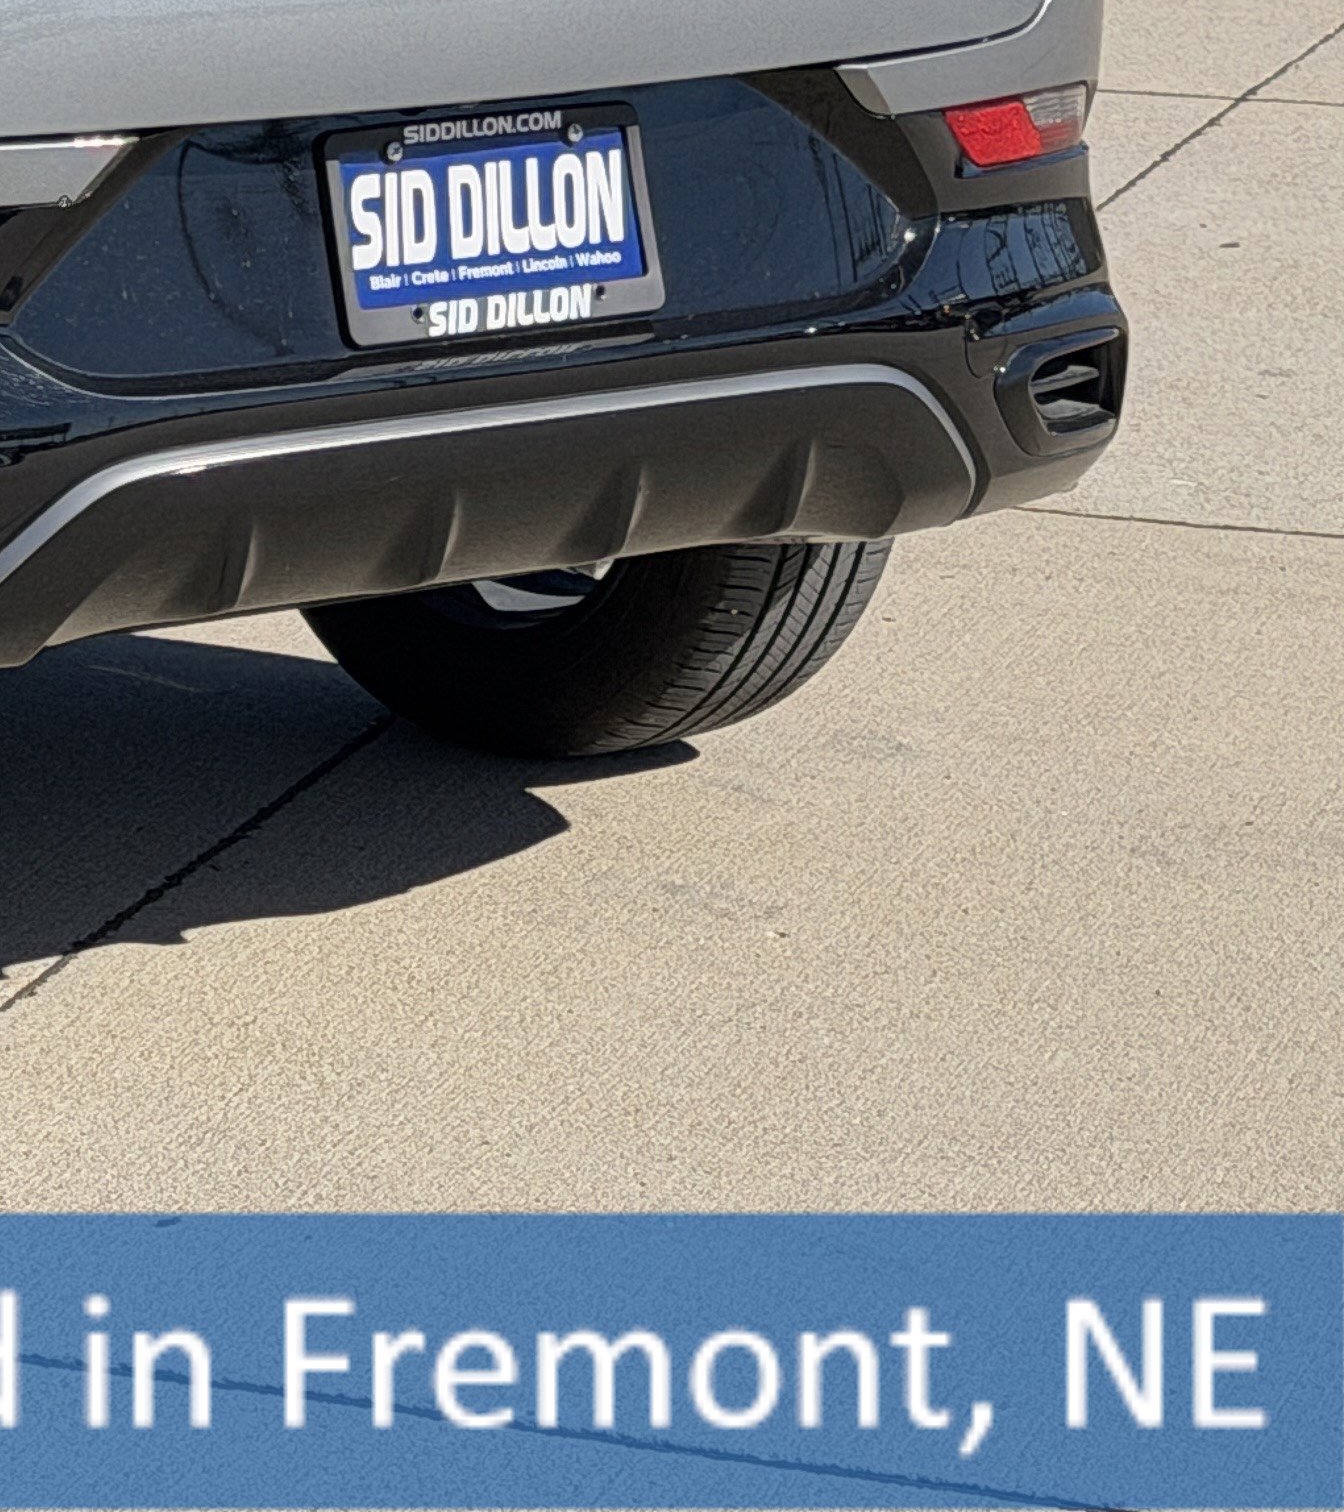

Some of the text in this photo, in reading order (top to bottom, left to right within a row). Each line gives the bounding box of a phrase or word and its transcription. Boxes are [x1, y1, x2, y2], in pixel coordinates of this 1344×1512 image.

[403, 111, 562, 145] SIDDILLON.COM
[350, 149, 624, 270] SID DILLON
[459, 261, 514, 280] Fremont
[576, 250, 622, 267] Wahoo
[428, 283, 593, 337] SID DILLON
